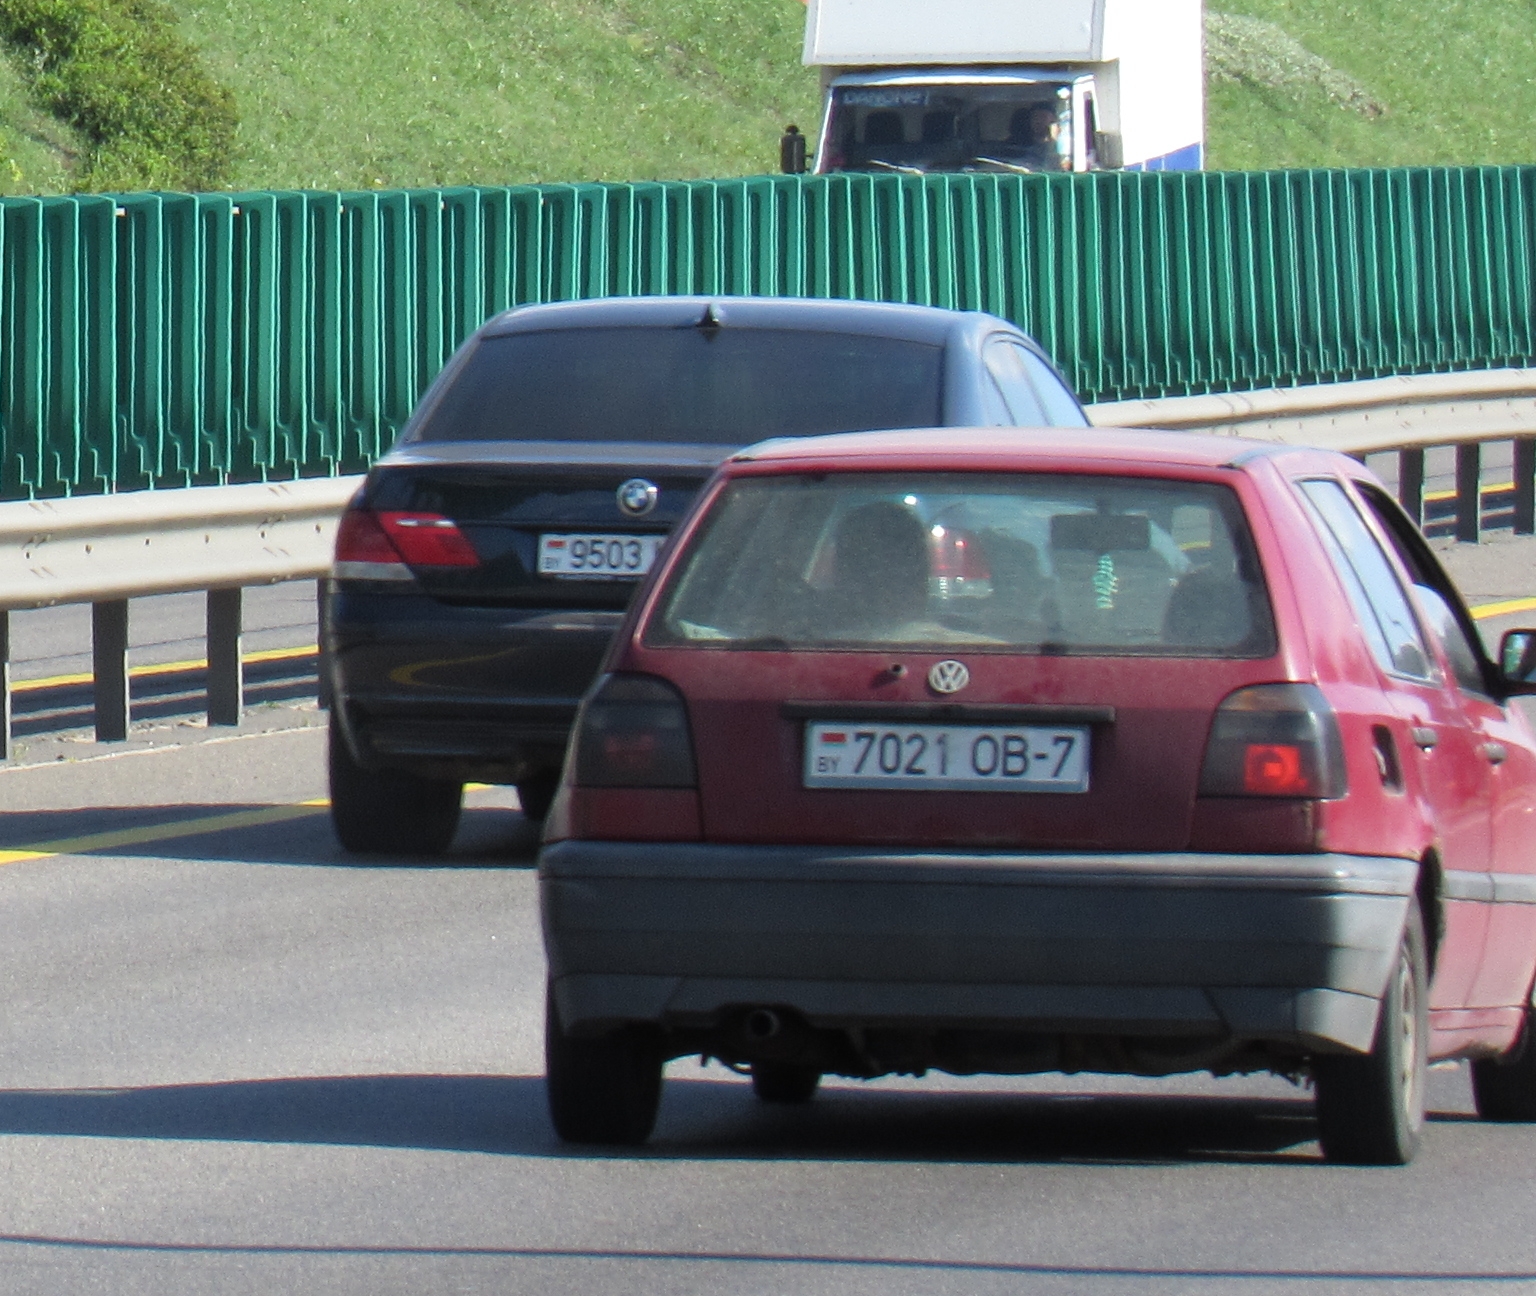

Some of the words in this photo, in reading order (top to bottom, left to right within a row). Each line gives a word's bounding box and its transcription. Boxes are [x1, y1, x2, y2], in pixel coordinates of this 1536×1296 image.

[571, 540, 642, 569] 9503
[817, 756, 838, 773] BY
[854, 731, 948, 776] 7021
